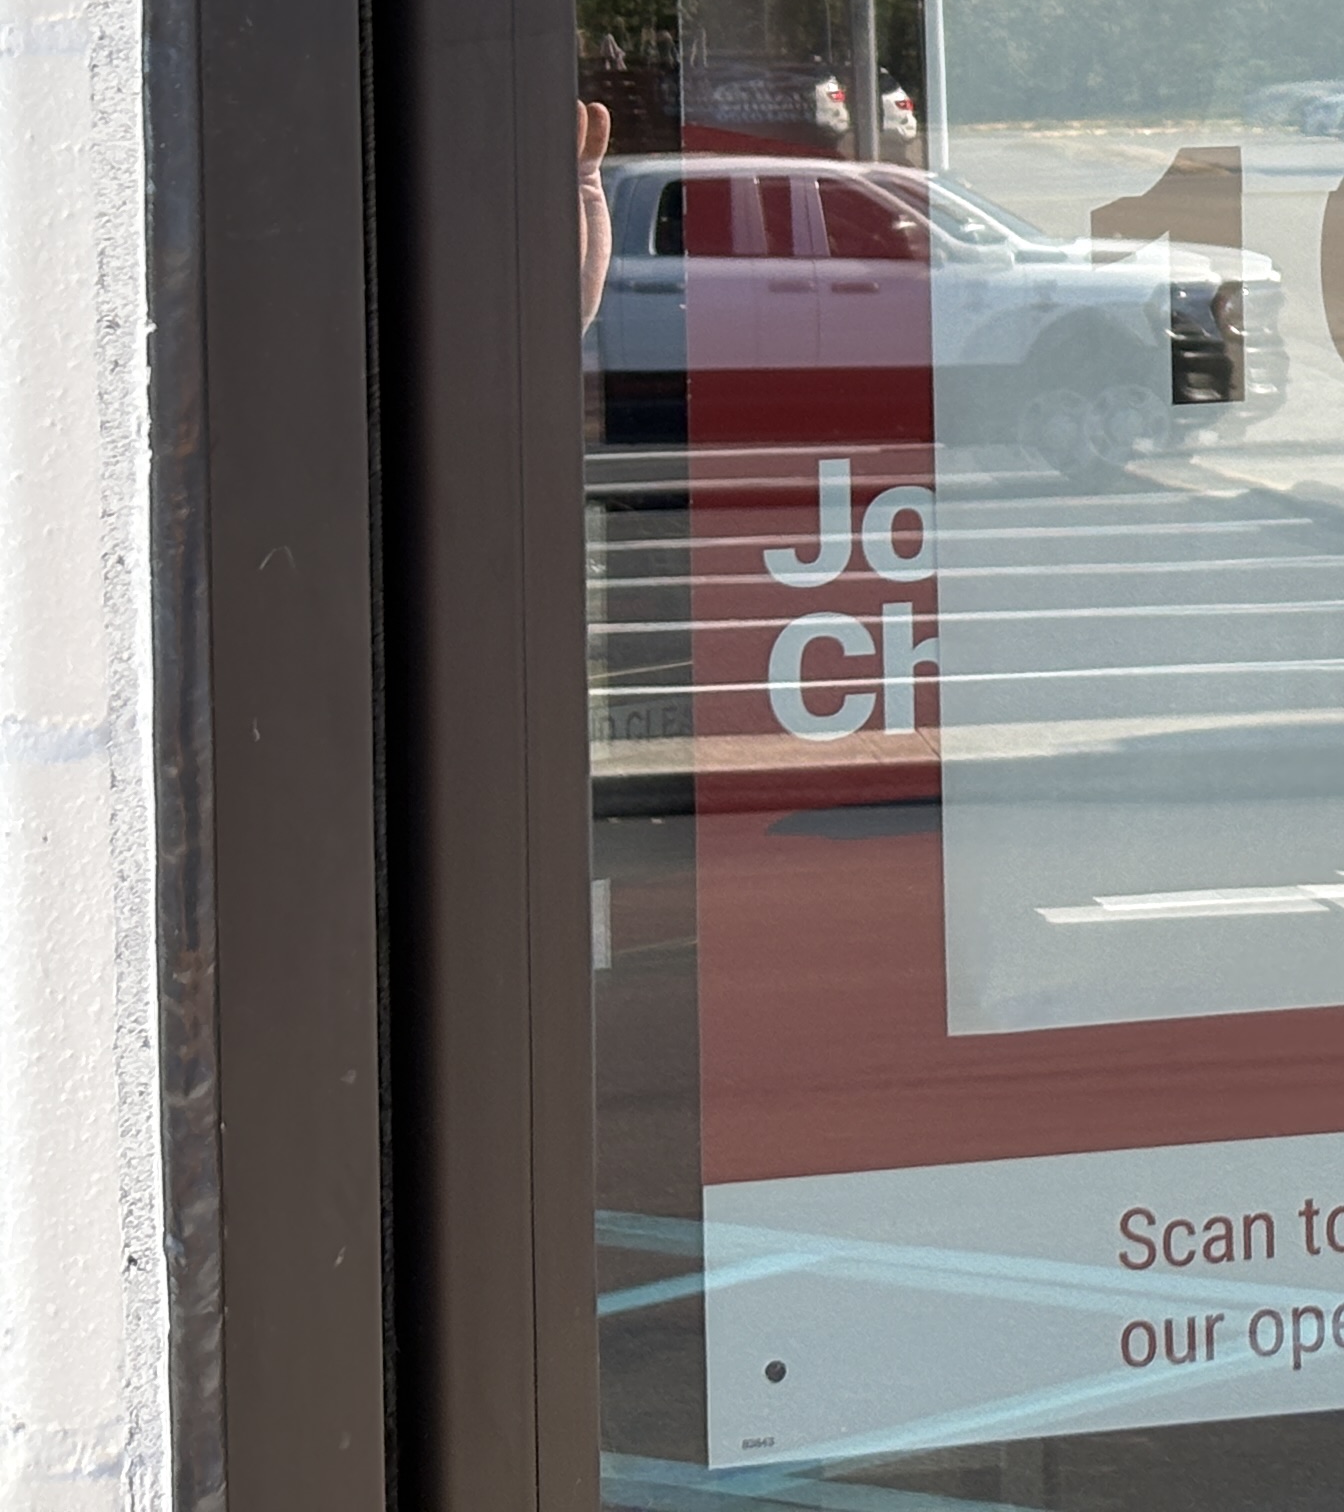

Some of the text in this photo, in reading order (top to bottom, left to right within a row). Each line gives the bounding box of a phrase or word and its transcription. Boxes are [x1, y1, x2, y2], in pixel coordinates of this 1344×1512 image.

[763, 458, 937, 588] Jo
[1118, 1206, 1276, 1271] Scan
[1120, 1312, 1225, 1369] our
